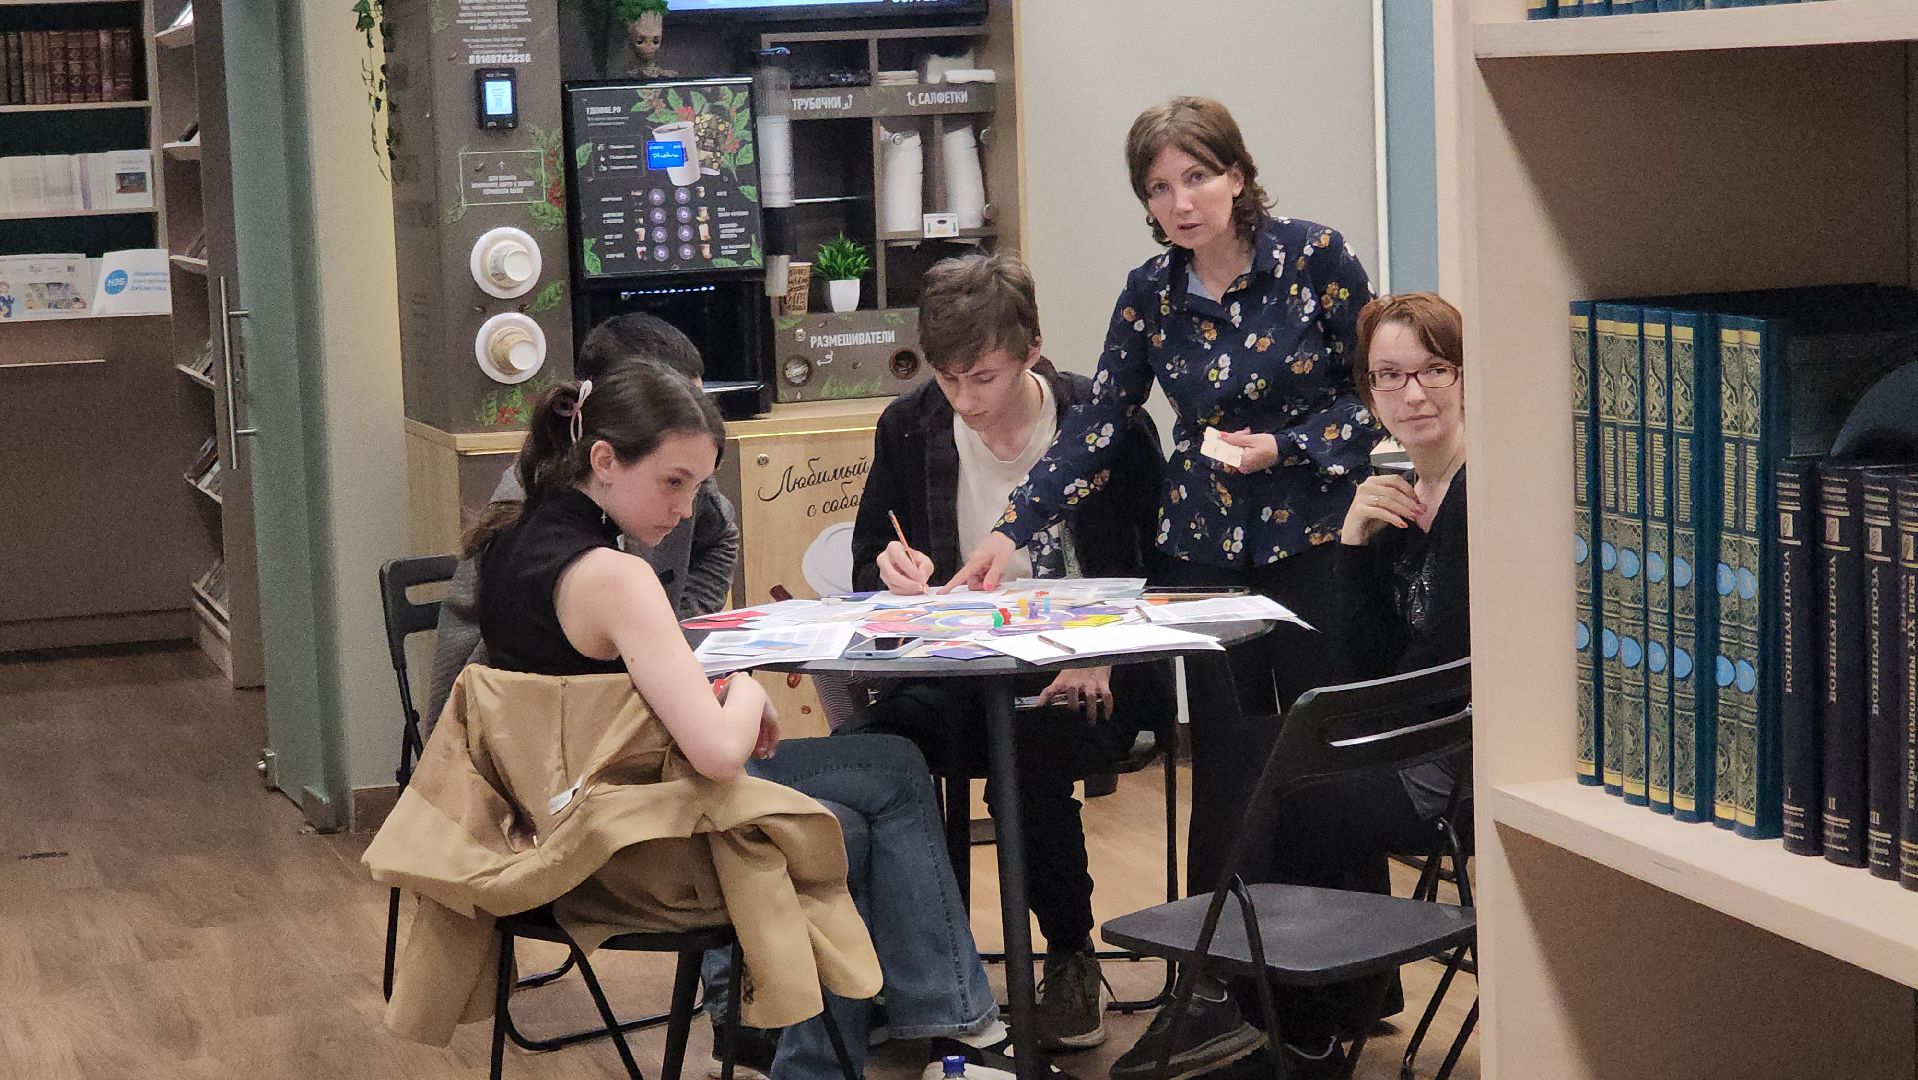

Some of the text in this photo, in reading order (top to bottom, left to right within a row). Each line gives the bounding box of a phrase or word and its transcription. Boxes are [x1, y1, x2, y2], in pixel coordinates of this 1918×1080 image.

[792, 96, 842, 110] ТРУБОЧКИ
[918, 91, 968, 104] САЛФЕТКИ
[810, 330, 896, 348] РАЗМЕШИВАТЕЛИ
[757, 456, 870, 502] Любимый
[822, 481, 862, 514] собо
[1829, 555, 1837, 613] ПРОЗА
